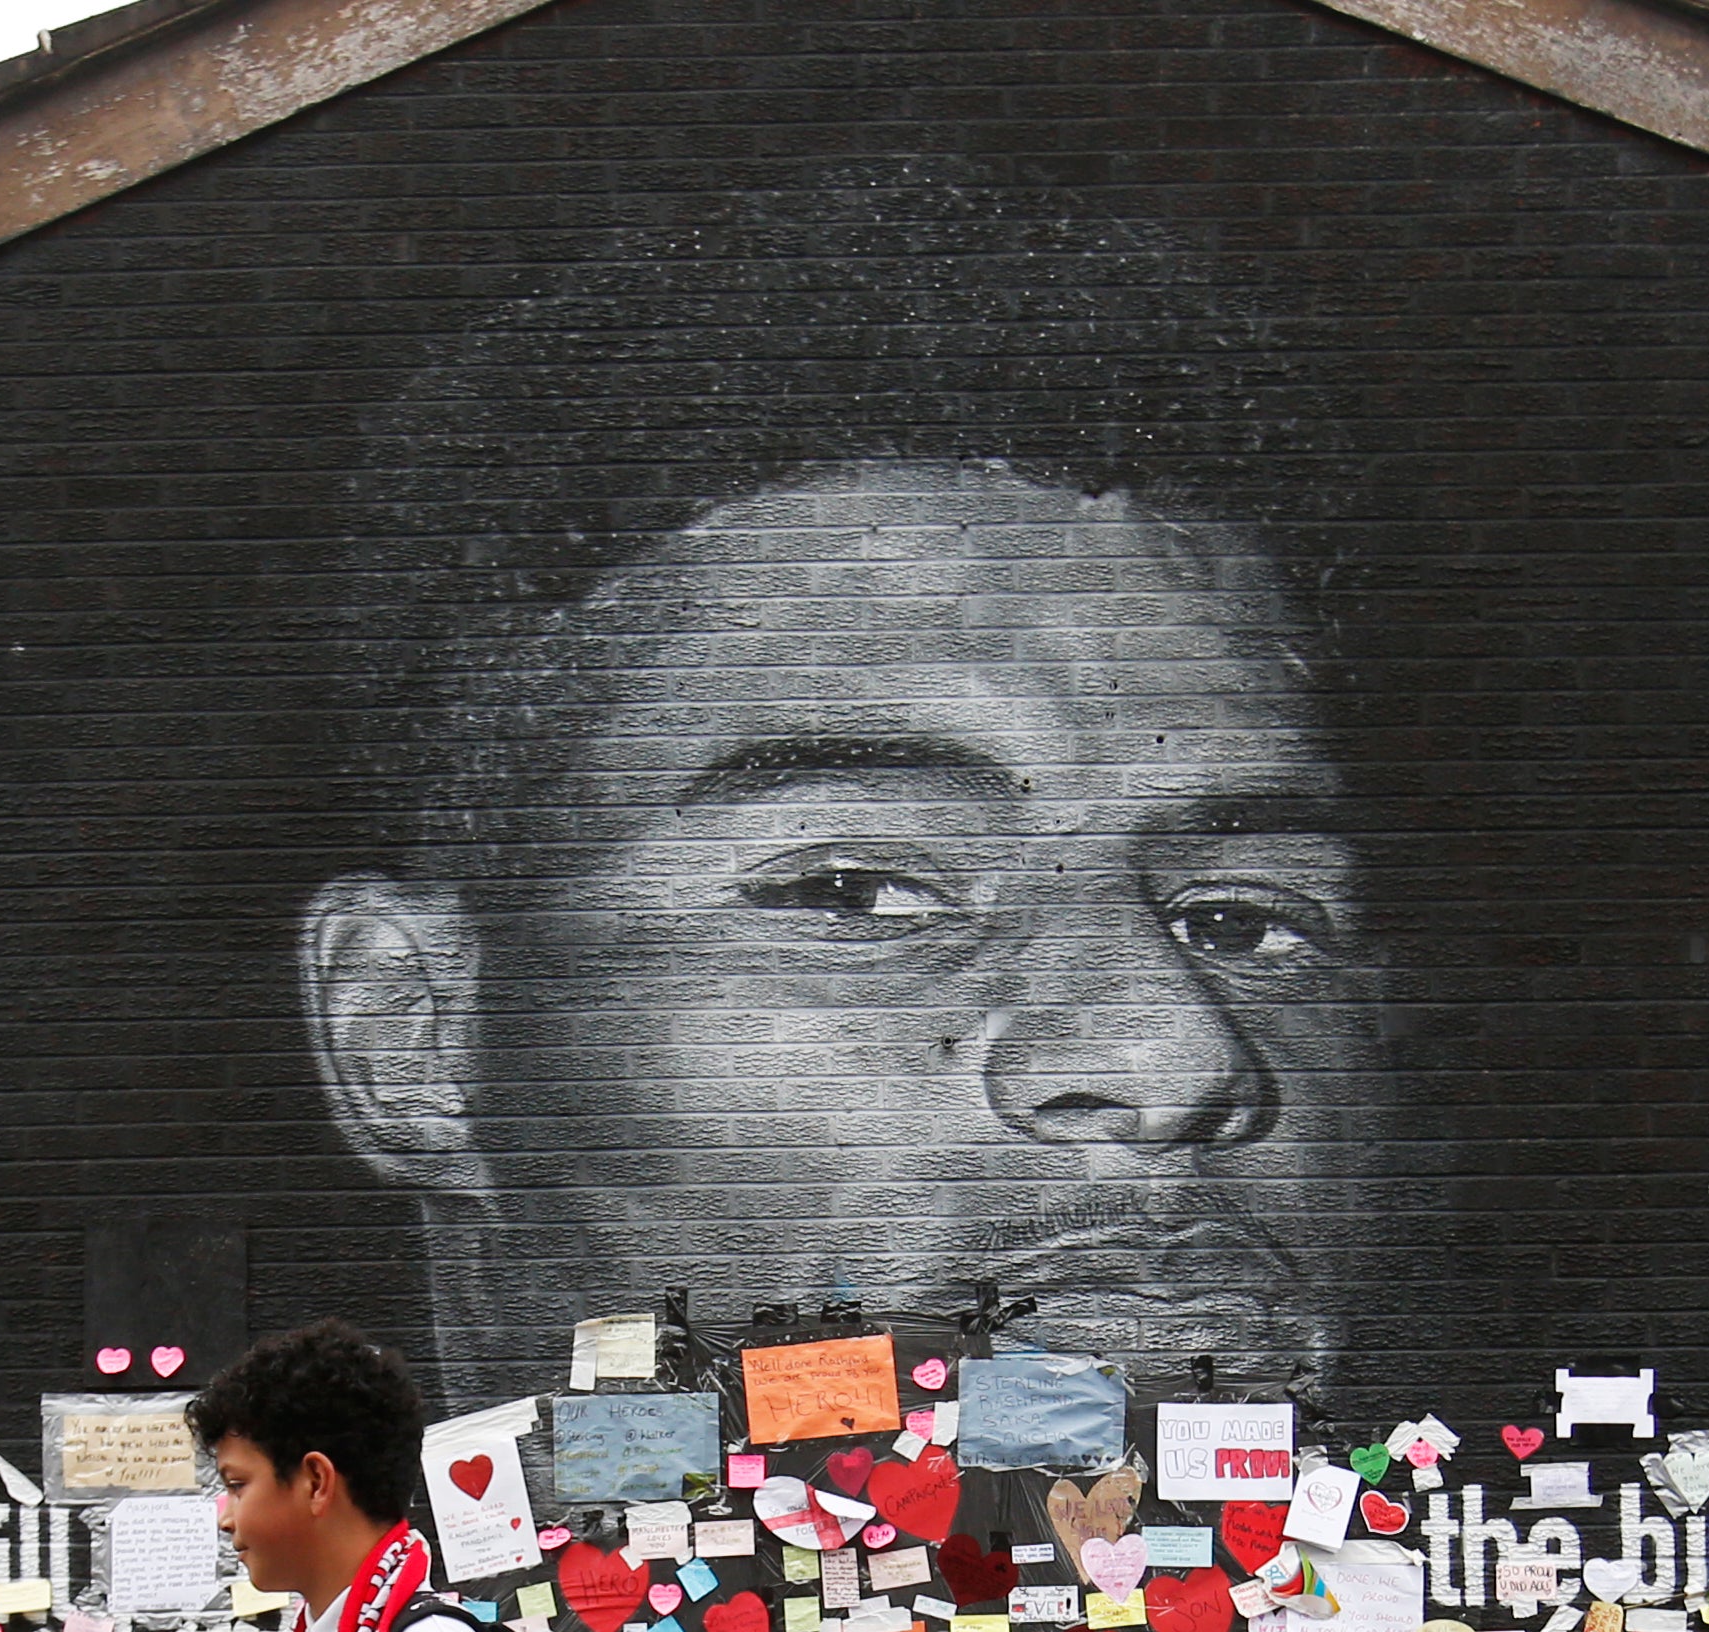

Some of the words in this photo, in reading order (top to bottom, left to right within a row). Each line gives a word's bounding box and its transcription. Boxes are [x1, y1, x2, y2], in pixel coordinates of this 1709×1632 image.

[784, 1357, 812, 1371] done
[975, 1376, 1066, 1392] STERLING
[557, 1401, 589, 1425] OUR
[608, 1402, 665, 1419] HEROES
[982, 1413, 1041, 1428] SAKA
[1159, 1419, 1211, 1441] YOU
[1220, 1419, 1286, 1442] MADE
[1163, 1447, 1209, 1480] US
[1214, 1447, 1291, 1480] PROUD
[1421, 1484, 1583, 1606] the
[1522, 1566, 1555, 1578] PROUD
[580, 1570, 640, 1606] HERO
